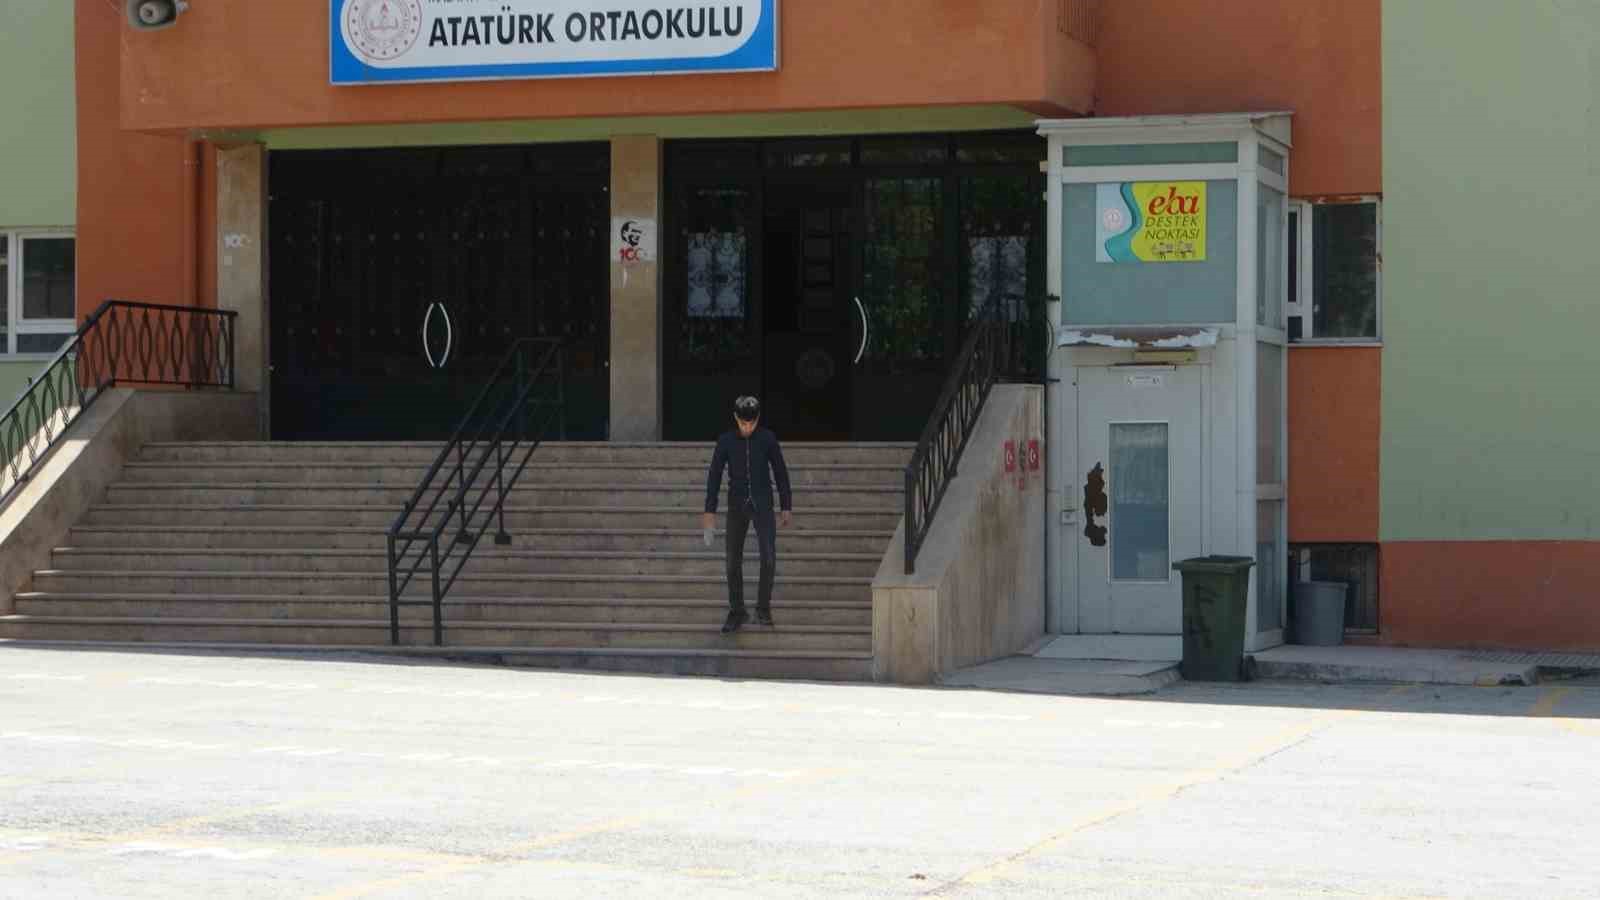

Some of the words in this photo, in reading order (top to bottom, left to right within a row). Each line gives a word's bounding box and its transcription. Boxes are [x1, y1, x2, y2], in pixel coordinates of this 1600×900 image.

[428, 5, 555, 47] ATATÜRK
[565, 6, 743, 43] ORTAOKULU
[1148, 186, 1200, 215] eba
[1145, 216, 1198, 228] DESTEK
